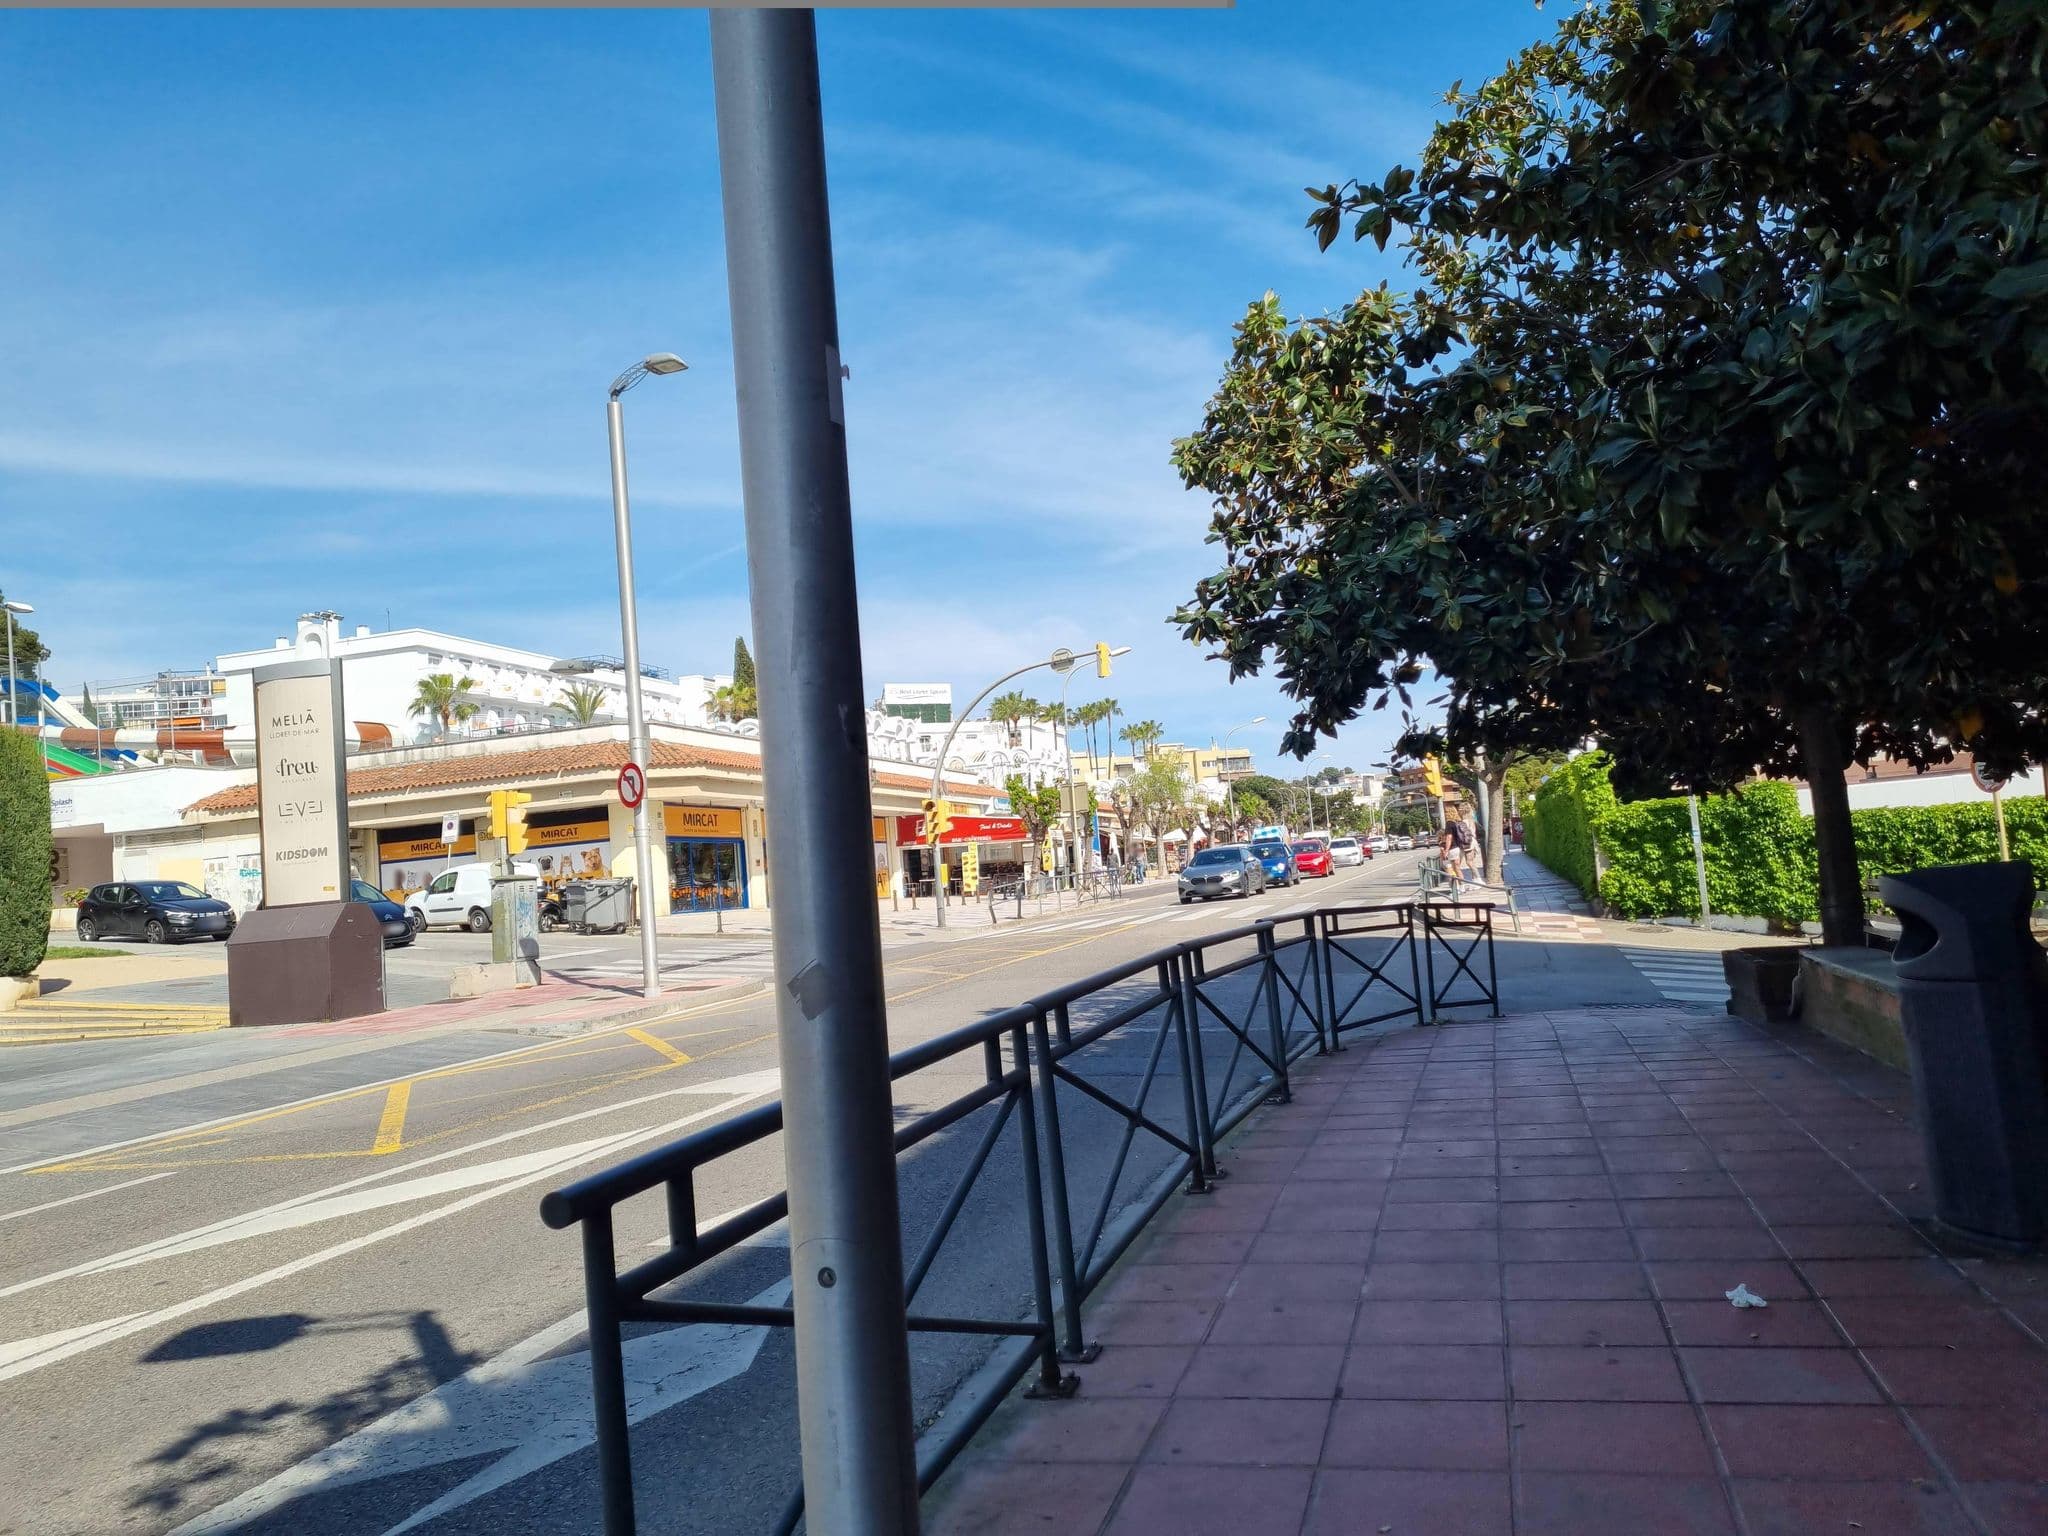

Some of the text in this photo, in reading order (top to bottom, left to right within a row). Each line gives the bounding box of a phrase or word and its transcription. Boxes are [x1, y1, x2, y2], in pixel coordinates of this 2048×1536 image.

[275, 758, 320, 777] freu
[278, 800, 323, 817] LEVEL
[682, 811, 719, 827] MIRCAT
[540, 827, 579, 840] MIRCAT
[275, 846, 329, 862] KIDSDOM
